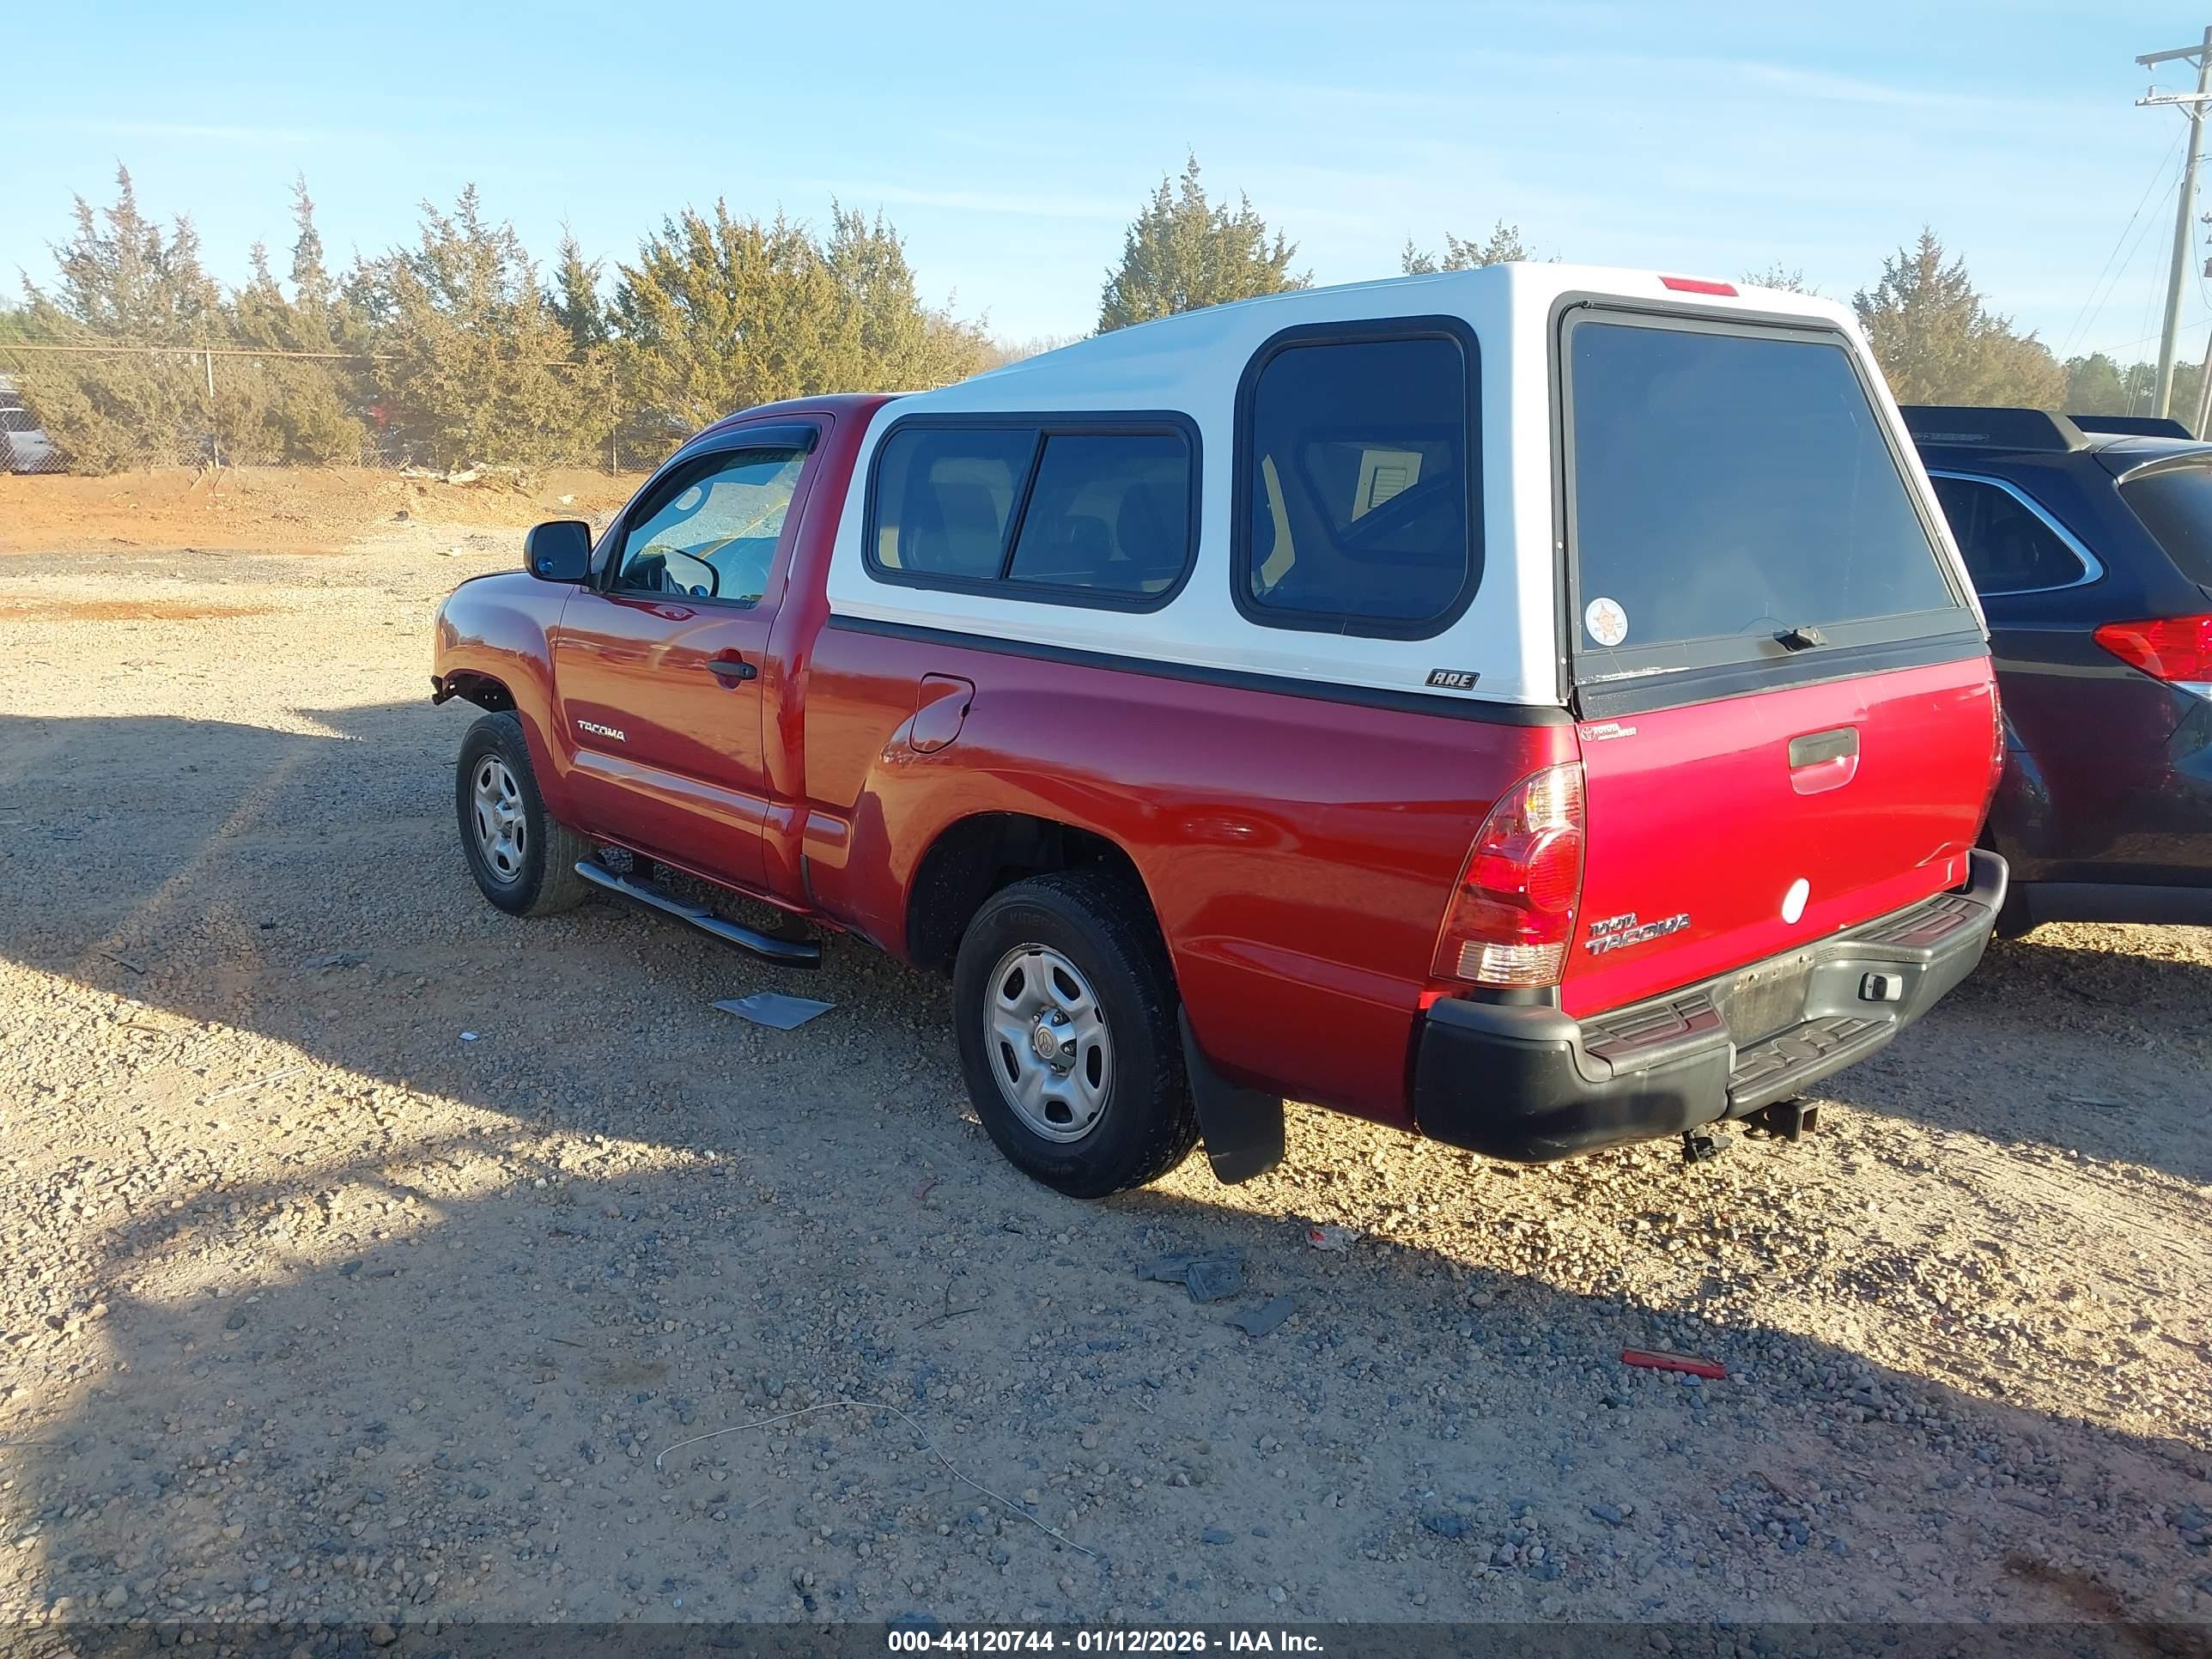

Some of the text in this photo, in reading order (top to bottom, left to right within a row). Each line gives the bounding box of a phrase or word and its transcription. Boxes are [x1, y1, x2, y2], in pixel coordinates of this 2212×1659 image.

[576, 720, 626, 743] TACOMA
[1584, 913, 1691, 956] TACOMA
[1589, 912, 1638, 937] TOYOTA
